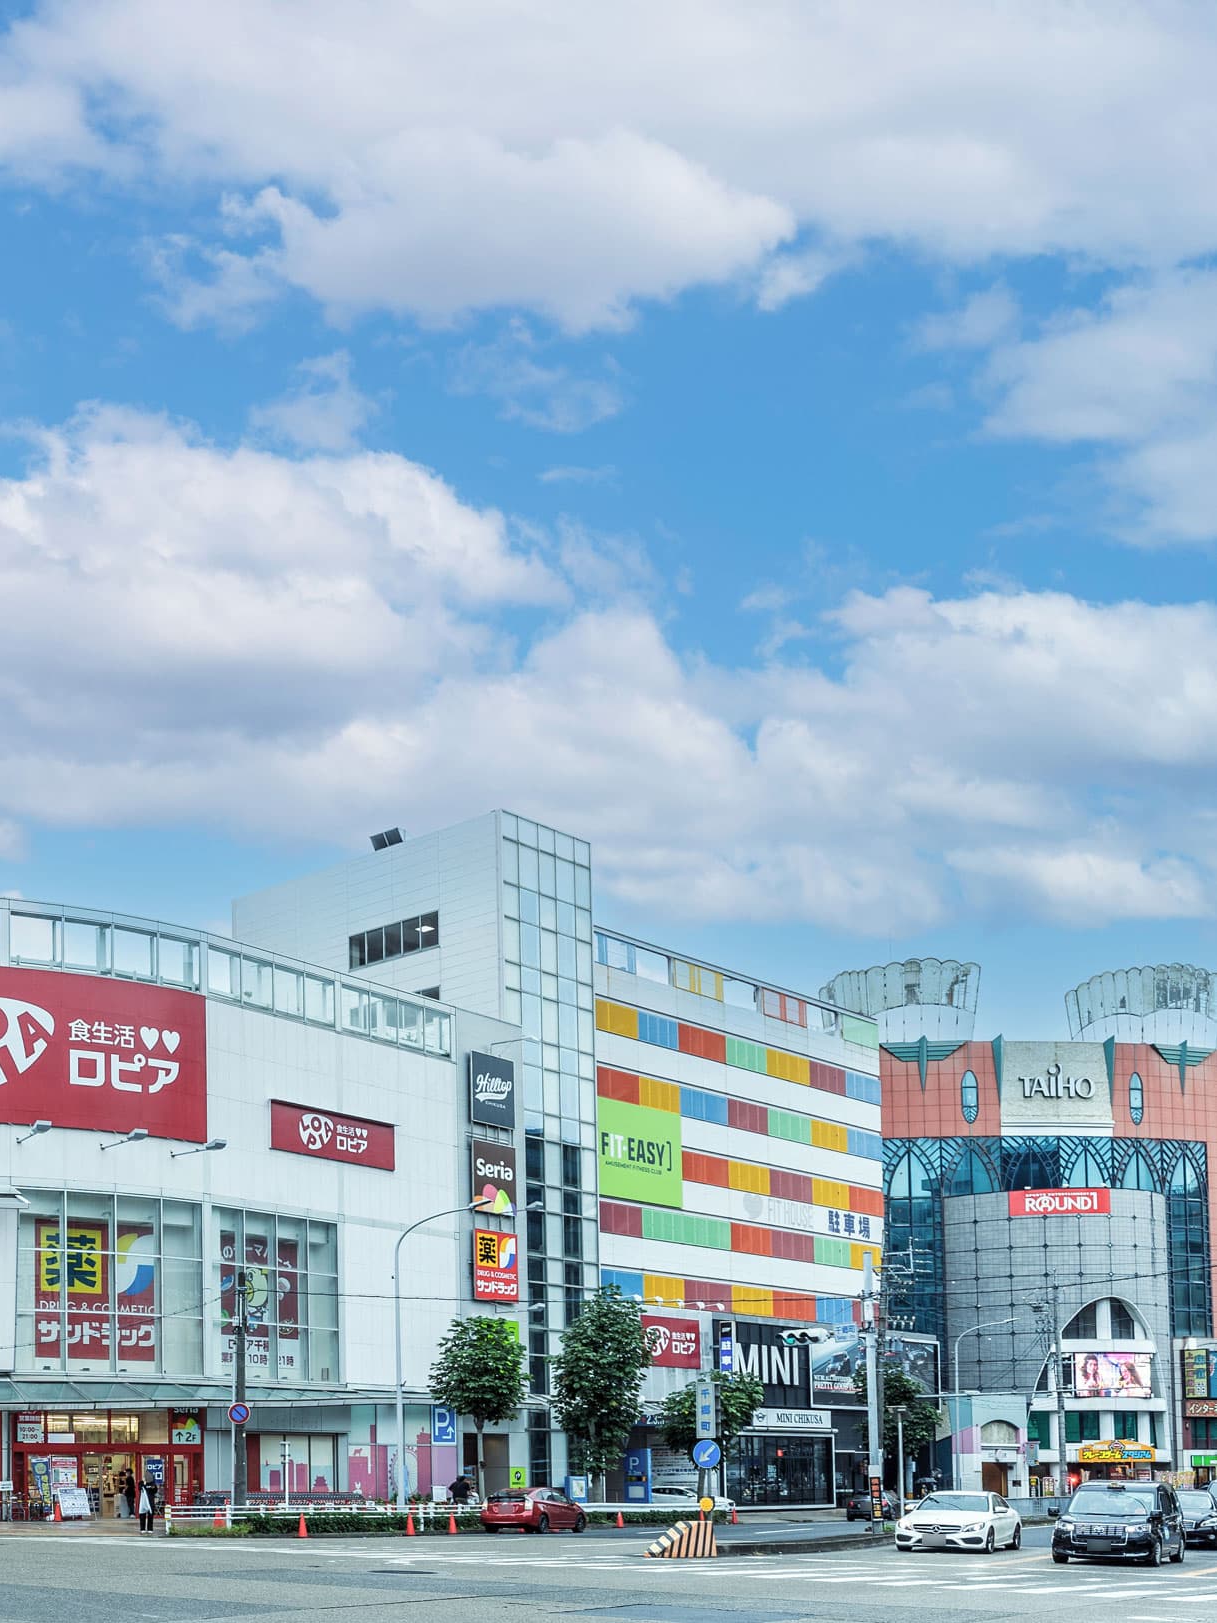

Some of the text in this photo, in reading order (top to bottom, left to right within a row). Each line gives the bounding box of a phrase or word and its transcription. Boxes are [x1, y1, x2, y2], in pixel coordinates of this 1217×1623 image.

[67, 1018, 136, 1049] 食生活
[69, 1048, 181, 1094] ロピア
[474, 1072, 512, 1095] Hilltop
[336, 1135, 368, 1154] ロピア
[476, 1158, 513, 1182] Seria
[1025, 1192, 1098, 1213] ROUND1
[828, 1210, 871, 1240] 駐車場
[45, 1233, 97, 1288] 薬
[478, 1235, 496, 1264] 薬
[477, 1269, 490, 1278] DRUG
[477, 1279, 518, 1296] サンドラッグ
[81, 1301, 90, 1312] &
[671, 1342, 696, 1355] ロピア
[734, 1343, 799, 1386] MINI
[435, 1407, 450, 1436] P
[776, 1411, 823, 1425] MINI CHIKUSA
[185, 1431, 196, 1442] 2F
[629, 1456, 640, 1468] P
